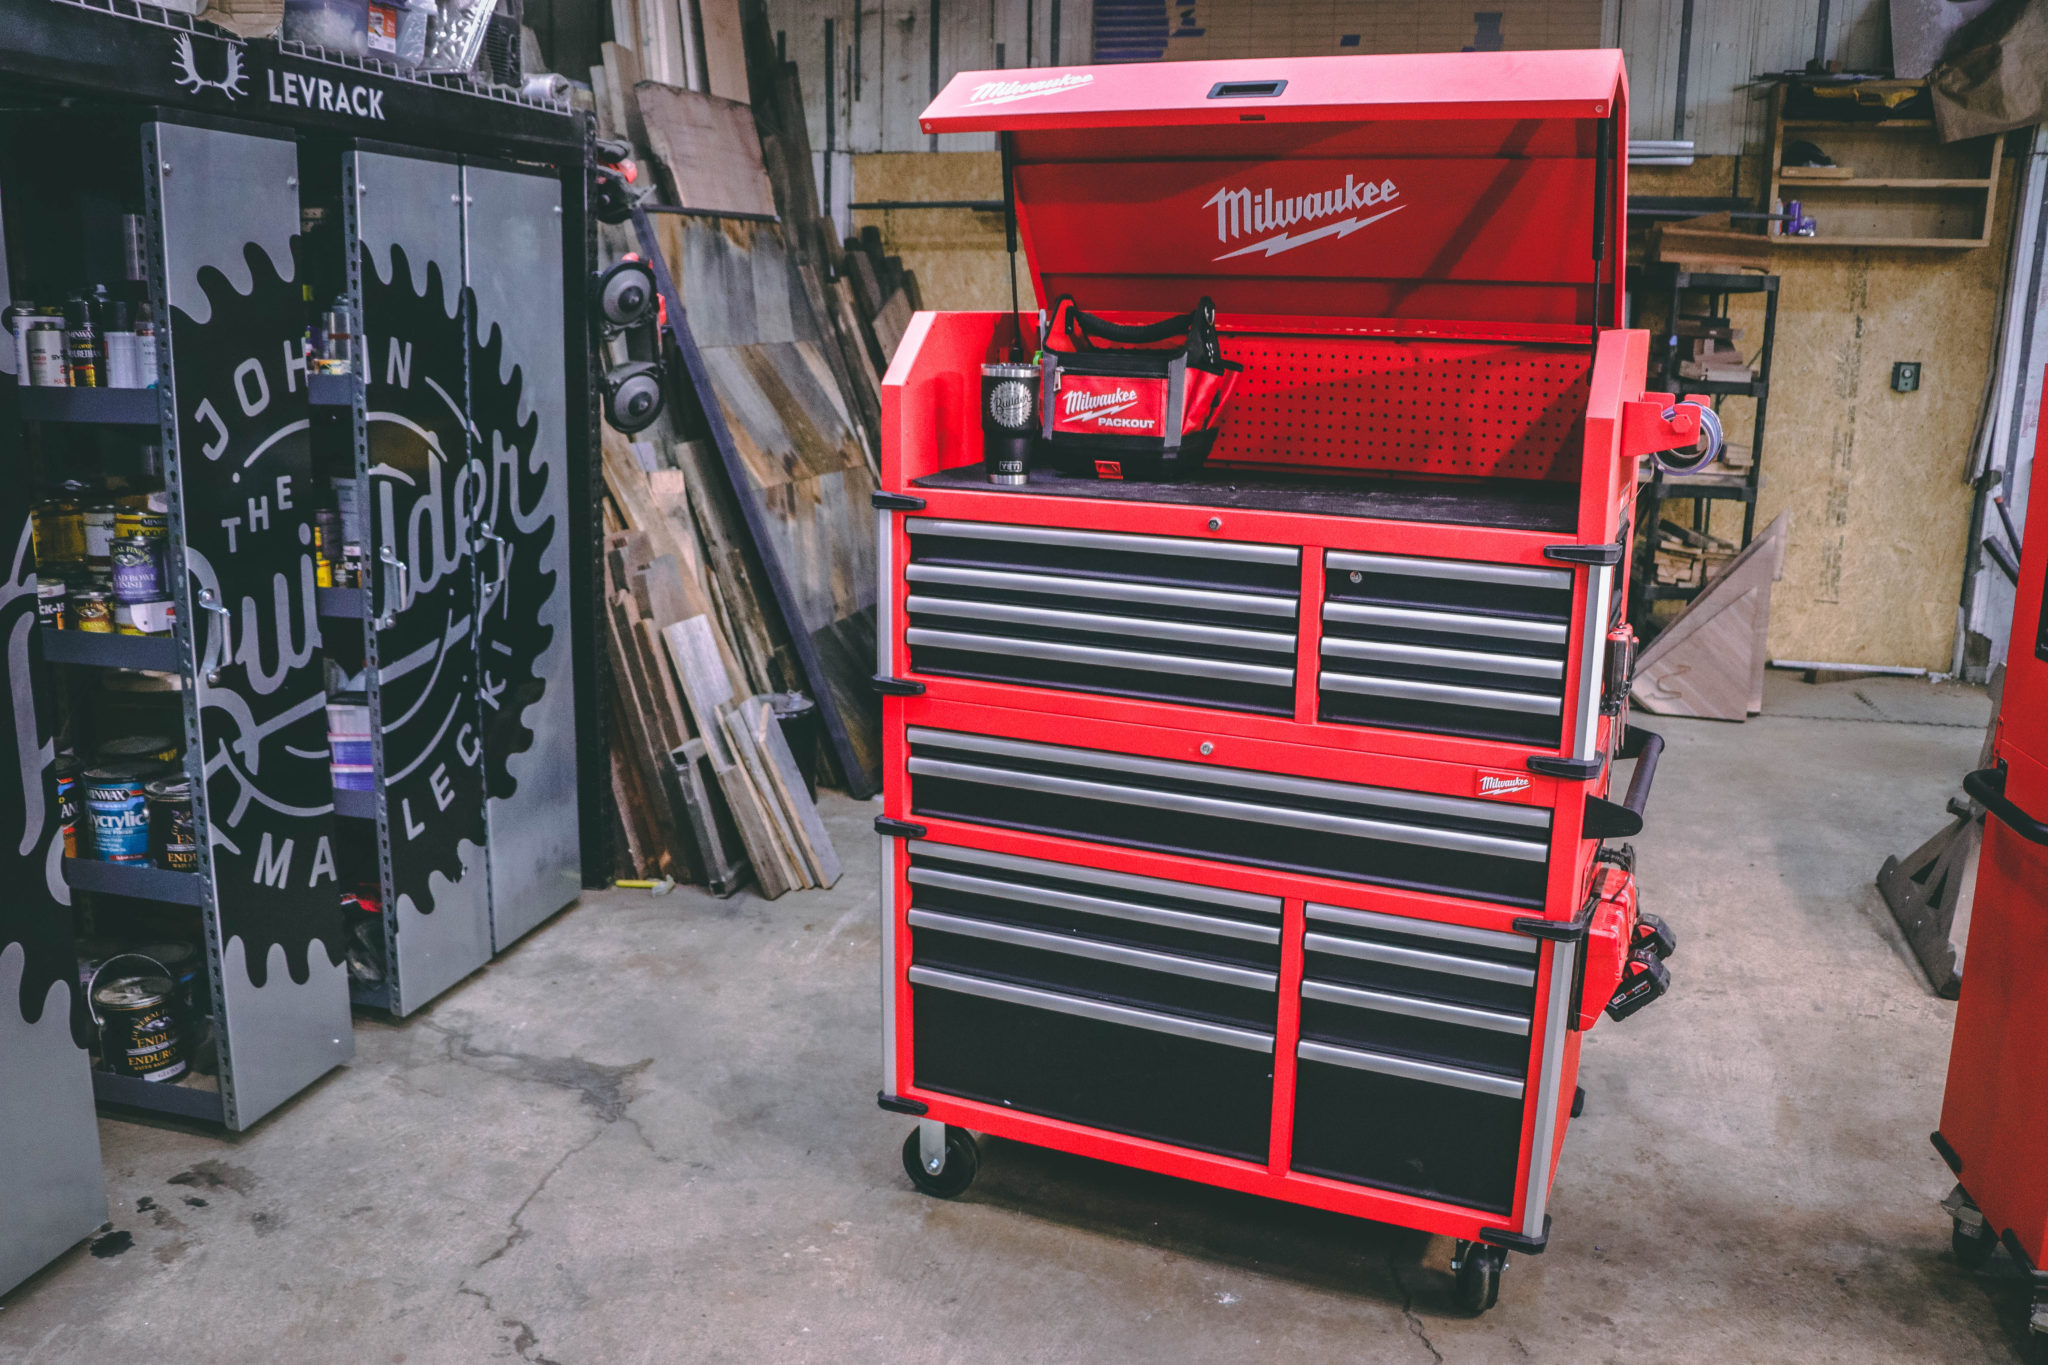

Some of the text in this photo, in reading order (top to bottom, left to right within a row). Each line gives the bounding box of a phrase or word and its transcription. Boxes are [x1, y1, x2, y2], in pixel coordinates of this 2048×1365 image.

[267, 69, 386, 120] LEVRACK
[969, 74, 1094, 102] Milwaukee
[1202, 173, 1401, 244] Milwaukee
[1062, 387, 1138, 415] Milwaukee
[1098, 417, 1155, 429] PACKOUT
[1001, 463, 1020, 472] YETI
[221, 474, 293, 553] THE
[1480, 776, 1529, 790] Milwaukee
